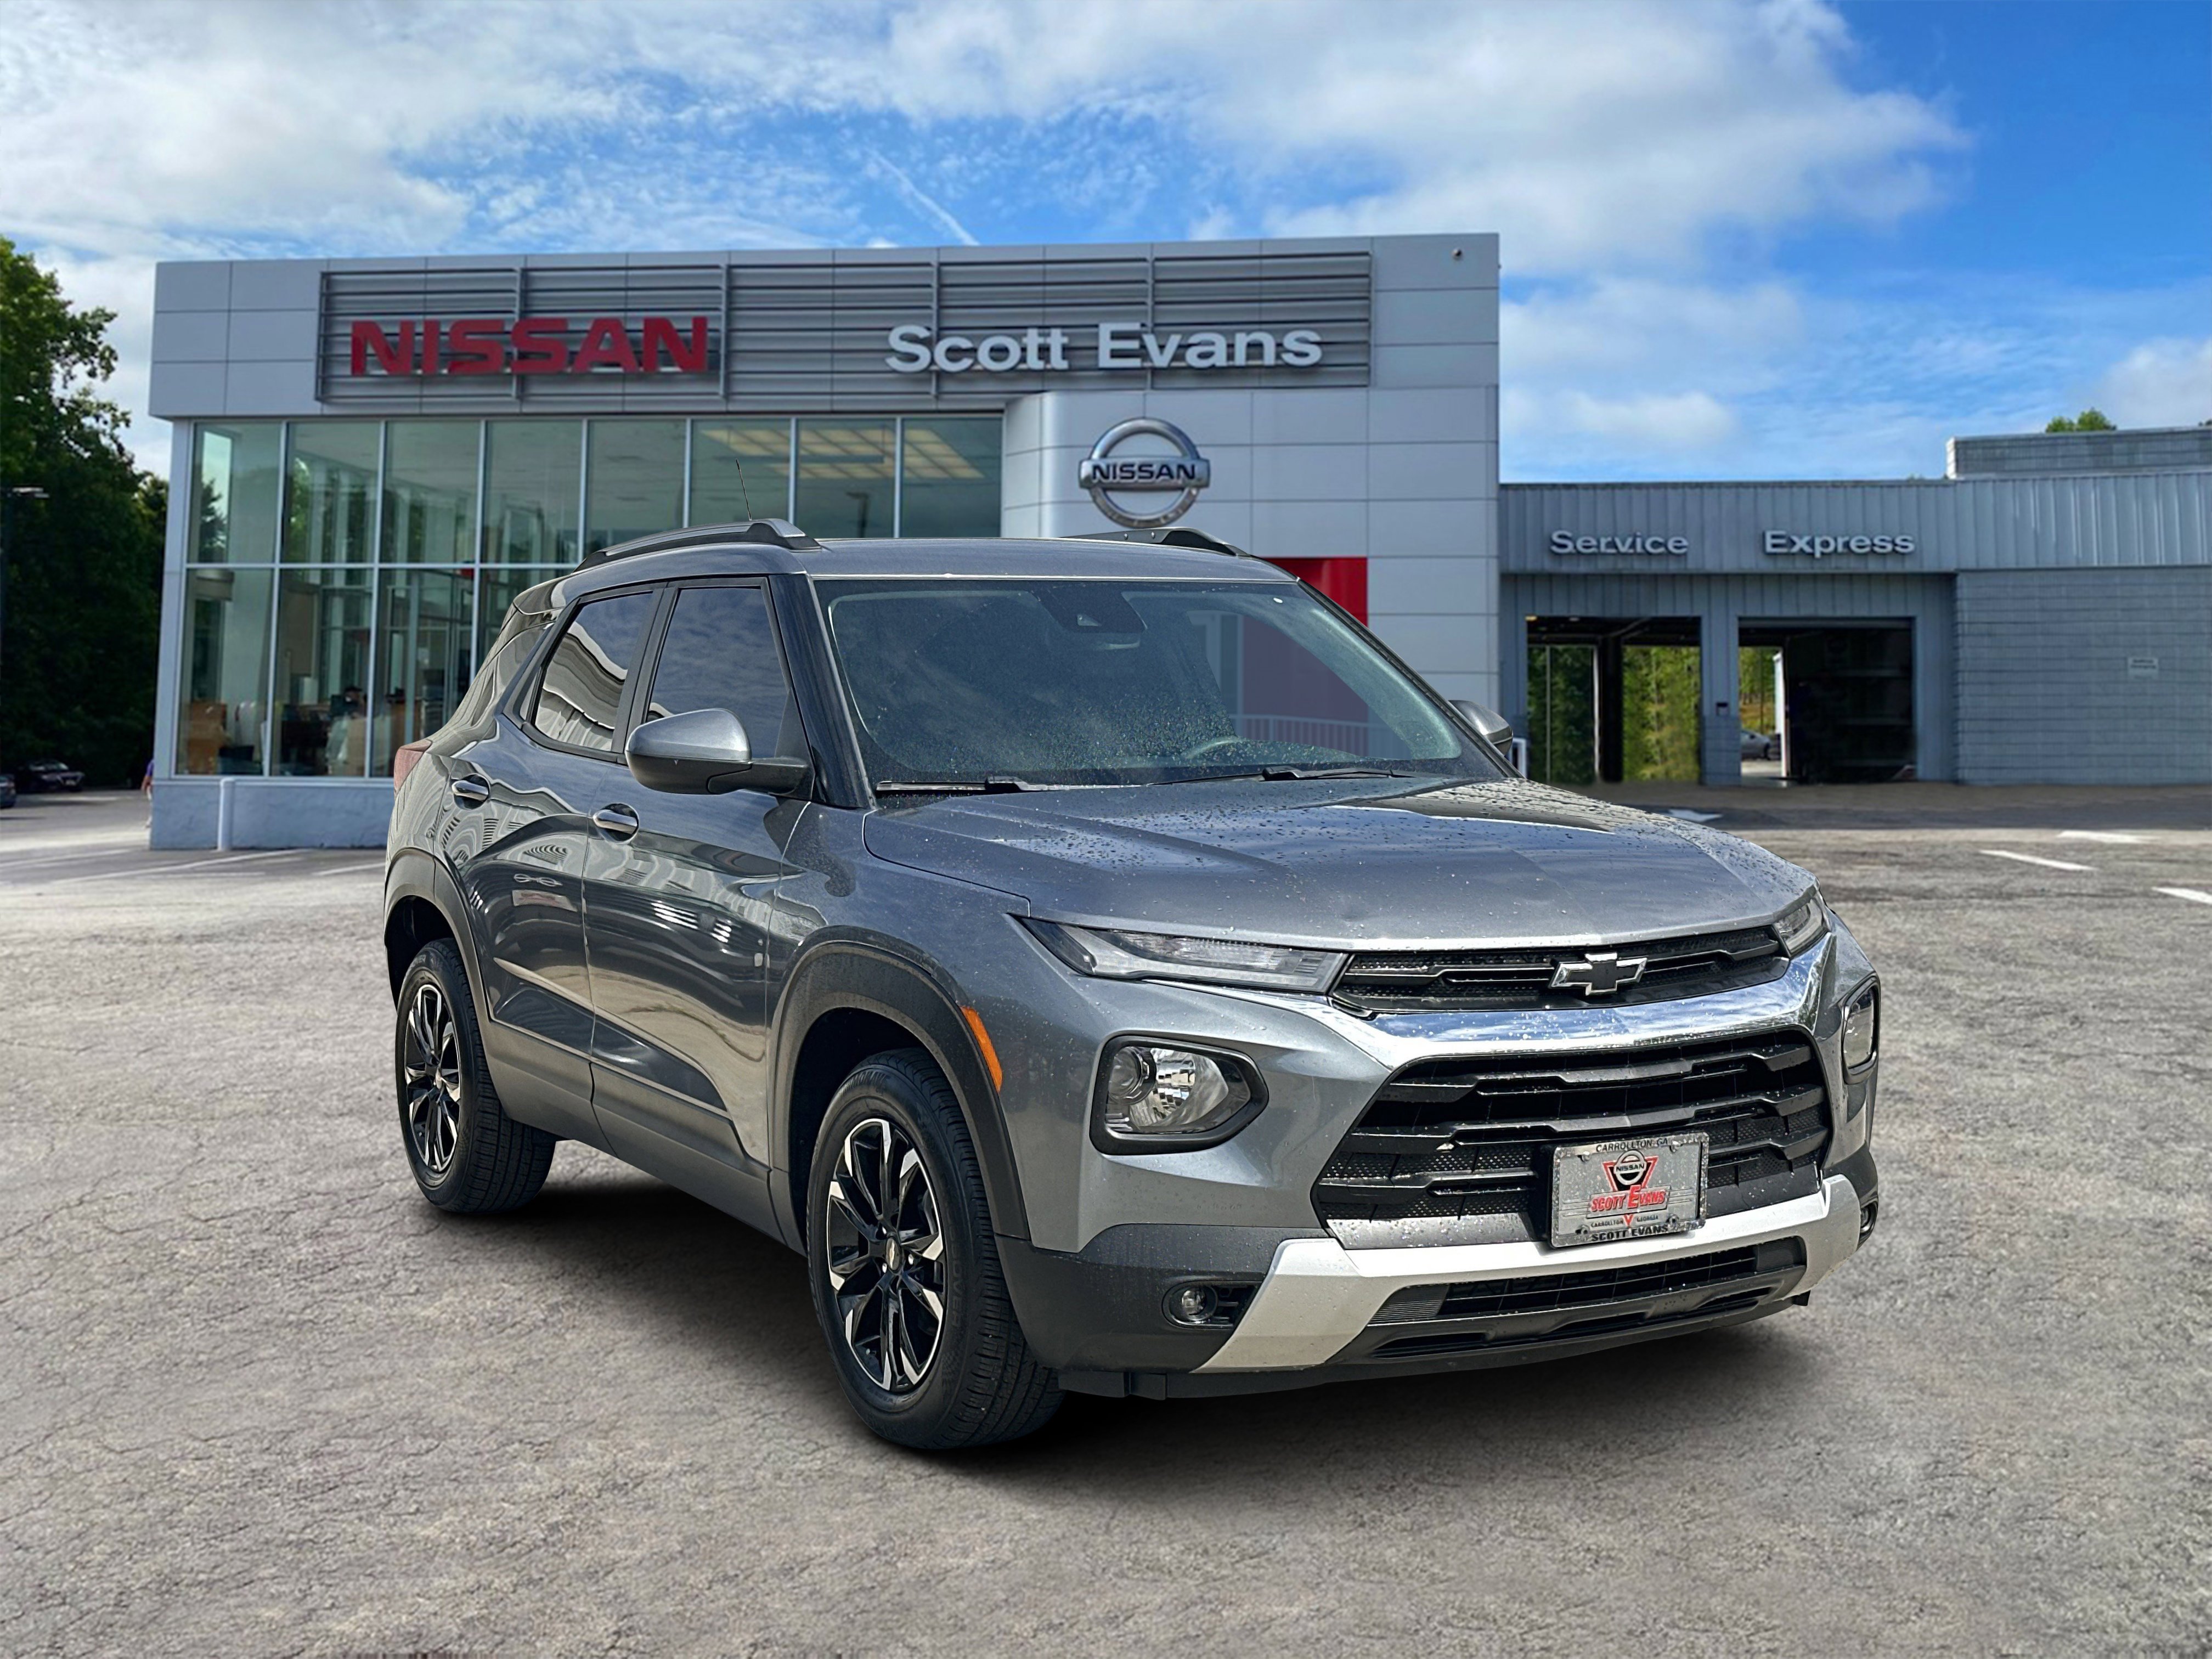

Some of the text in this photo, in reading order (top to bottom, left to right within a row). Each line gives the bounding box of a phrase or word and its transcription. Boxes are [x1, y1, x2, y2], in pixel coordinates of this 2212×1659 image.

[351, 317, 708, 375] NISSAN
[885, 323, 1322, 372] Scott Evans
[1092, 464, 1195, 480] NISSAN
[1551, 530, 1915, 557] Service Express
[1596, 1139, 1652, 1152] CARROLLTON
[1616, 1164, 1645, 1172] NISSAN
[1590, 1184, 1666, 1212] SCOTT EVANS
[1592, 1225, 1668, 1242] SCOTT EVANS
